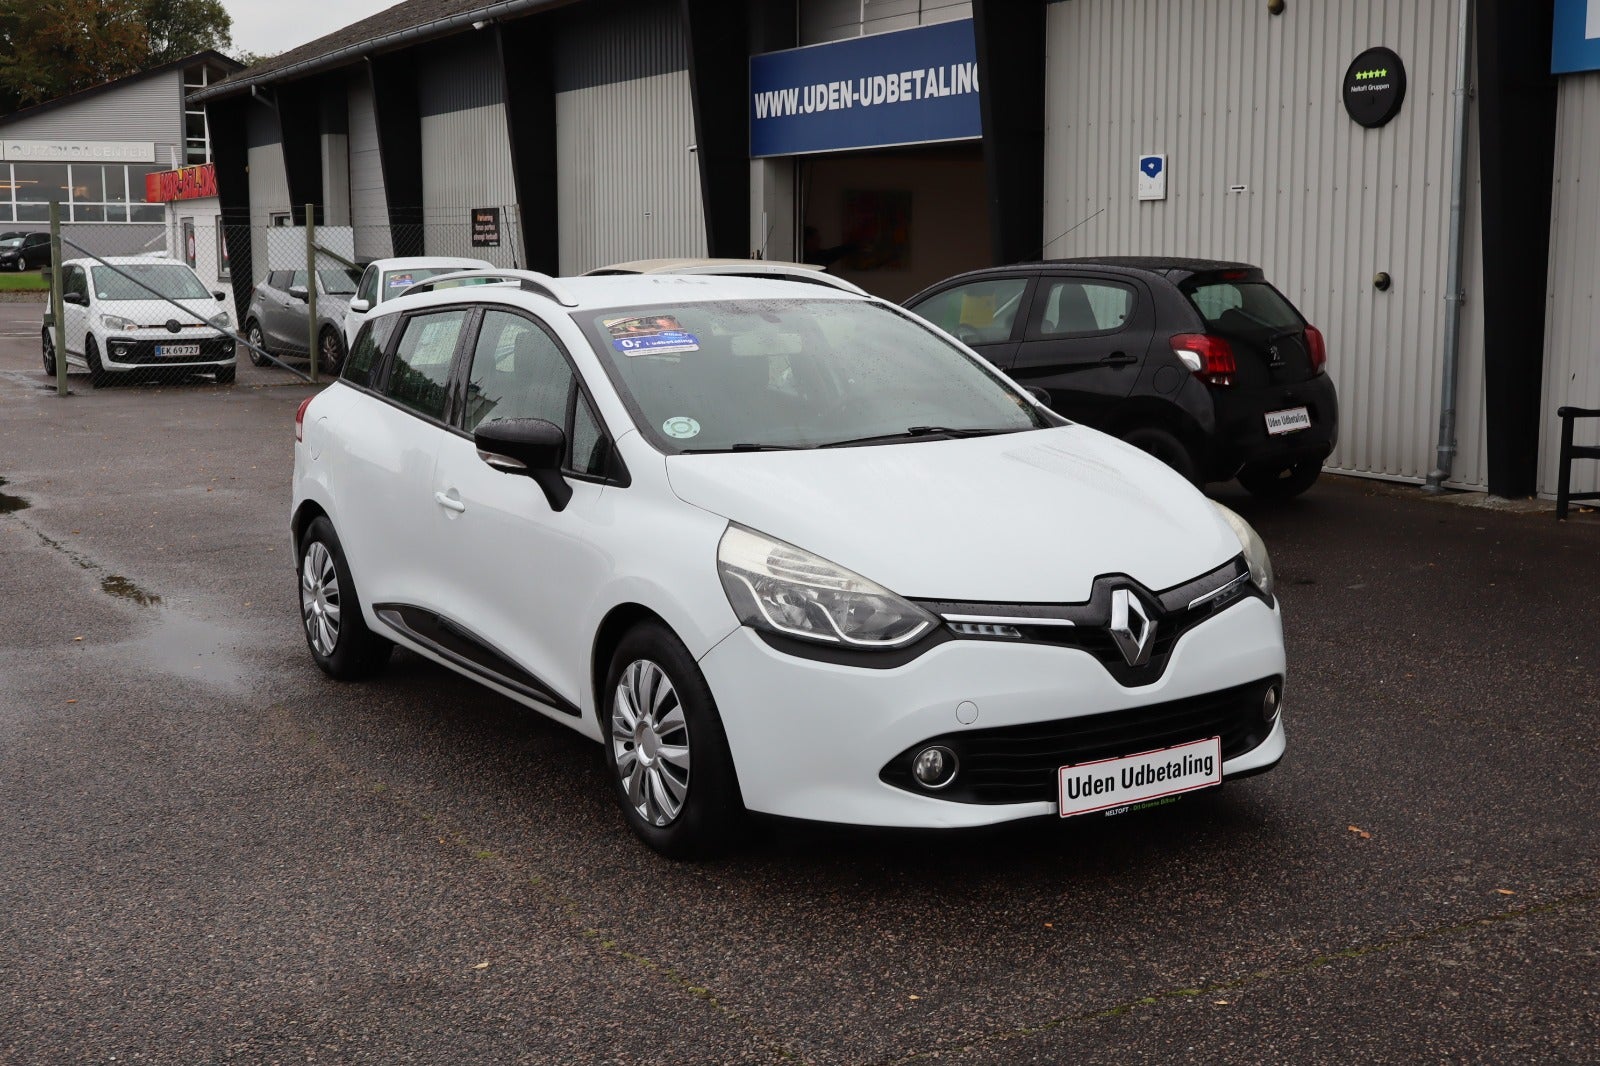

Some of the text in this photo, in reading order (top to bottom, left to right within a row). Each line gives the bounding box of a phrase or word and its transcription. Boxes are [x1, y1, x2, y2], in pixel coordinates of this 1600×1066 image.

[1351, 83, 1390, 93] Neltoft Gruppen
[161, 346, 199, 355] EK 69 727
[1267, 413, 1308, 428] Uden Udbetaling
[1067, 754, 1213, 799] Uden Udbetaling
[1105, 806, 1129, 817] NELTOFT
